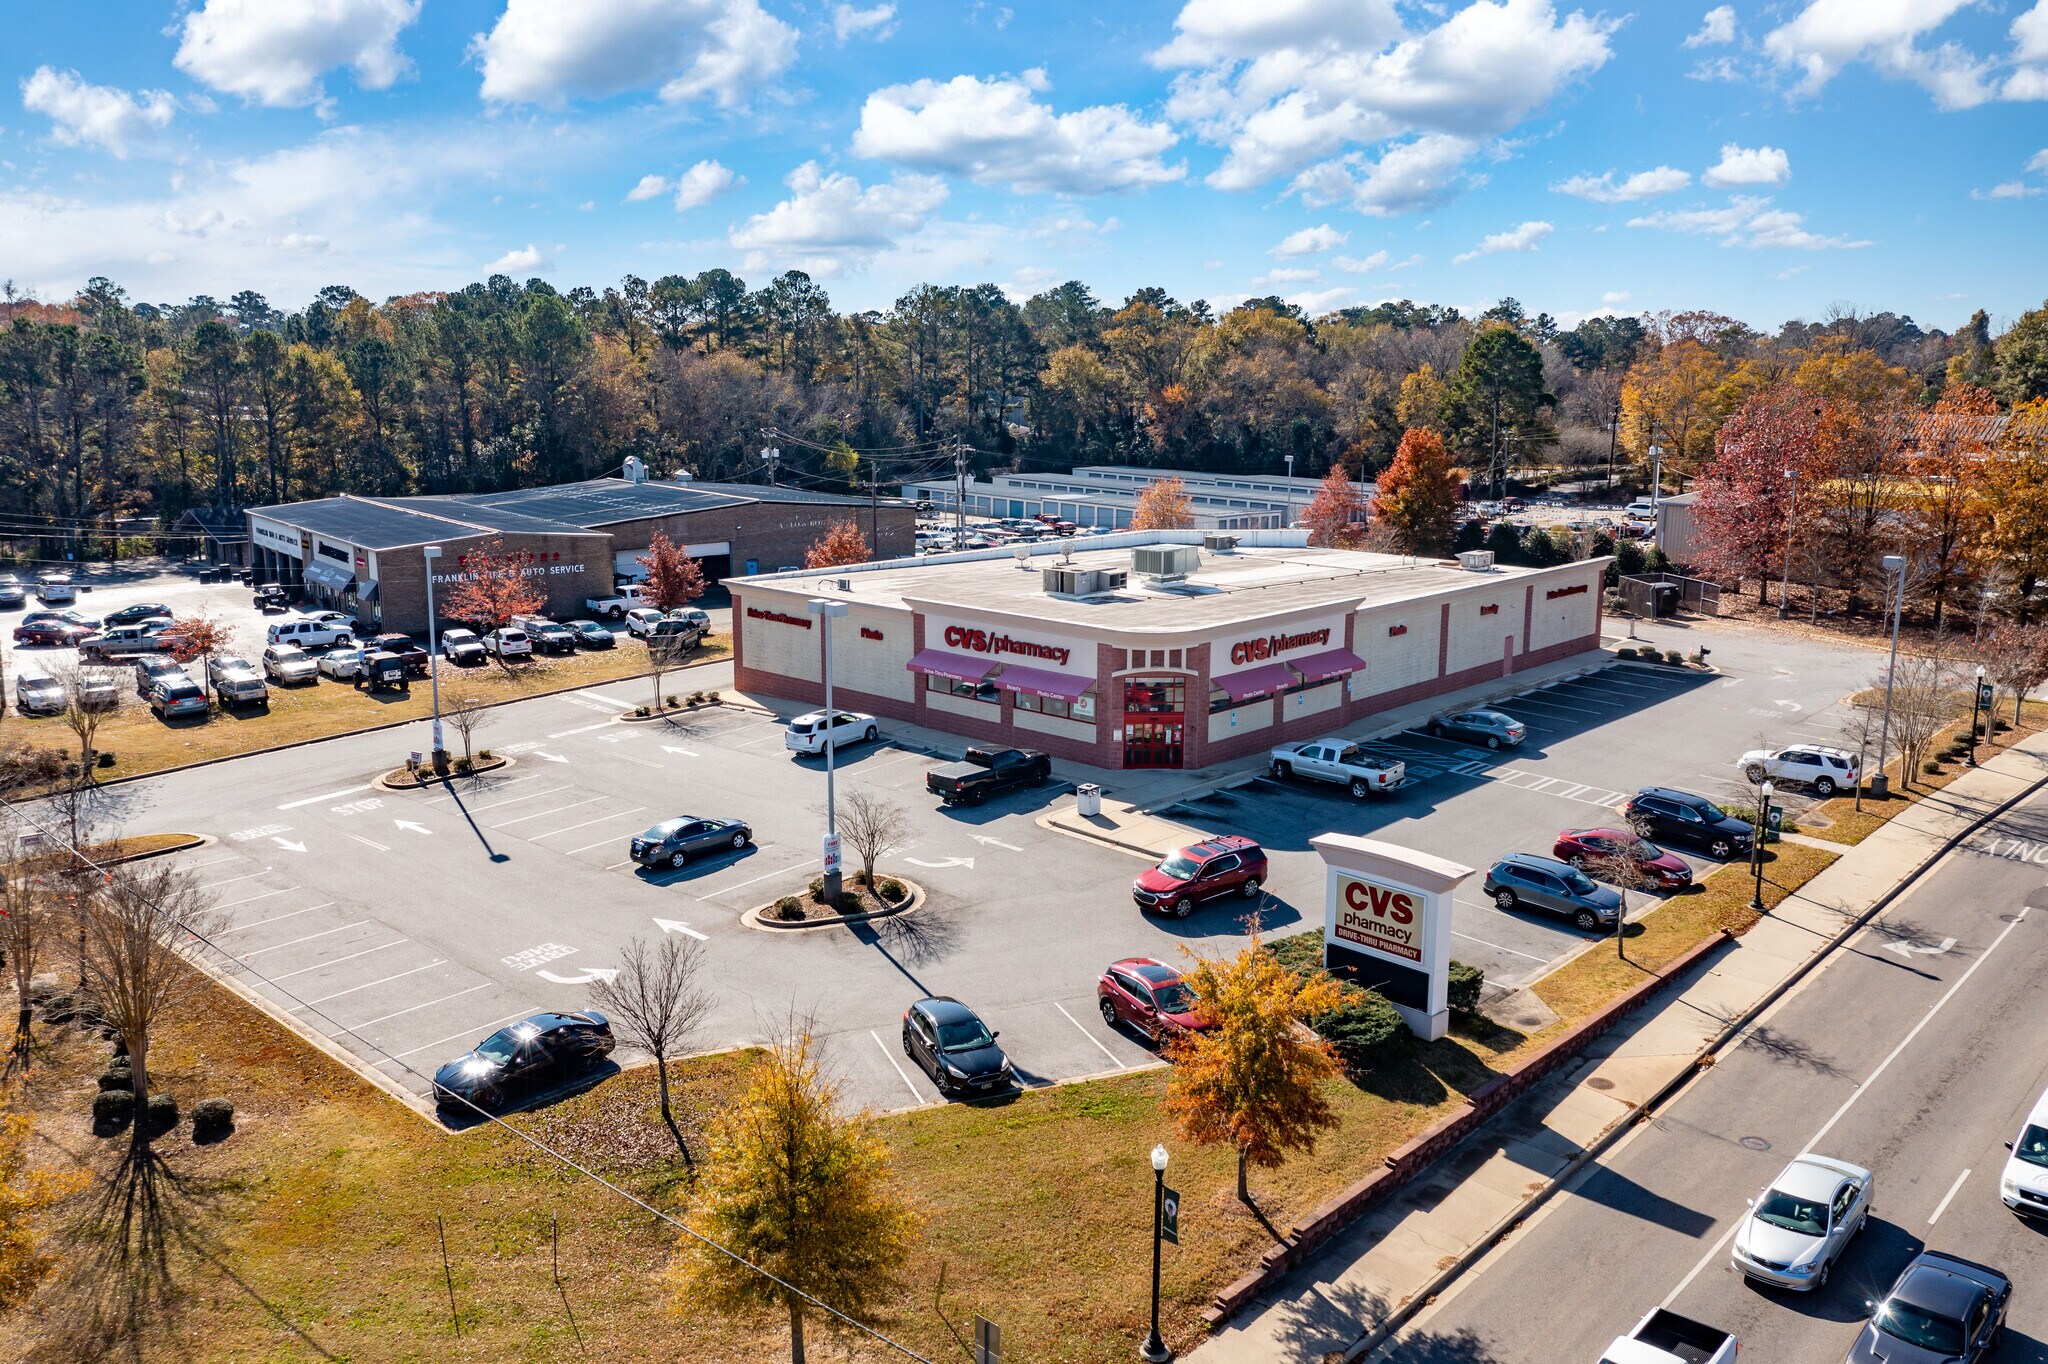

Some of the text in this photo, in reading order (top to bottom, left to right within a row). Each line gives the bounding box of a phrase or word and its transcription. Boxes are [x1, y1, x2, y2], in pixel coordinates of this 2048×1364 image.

[432, 571, 479, 584] FRANKLIN
[520, 567, 545, 577] AUTO
[550, 564, 585, 575] SERVICE
[861, 627, 883, 641] Photo
[923, 668, 963, 681] Drive-Thru Pharmacy
[1006, 684, 1022, 693] Beauty
[1276, 682, 1288, 690] Beauty
[1037, 690, 1065, 700] Photo Center
[1242, 688, 1265, 699] Photo Center
[331, 798, 384, 816] STOP
[1345, 881, 1413, 924] CVS
[1344, 912, 1412, 944] pharmacy
[1338, 927, 1417, 958] DRIVE-THRU PHARMACY
